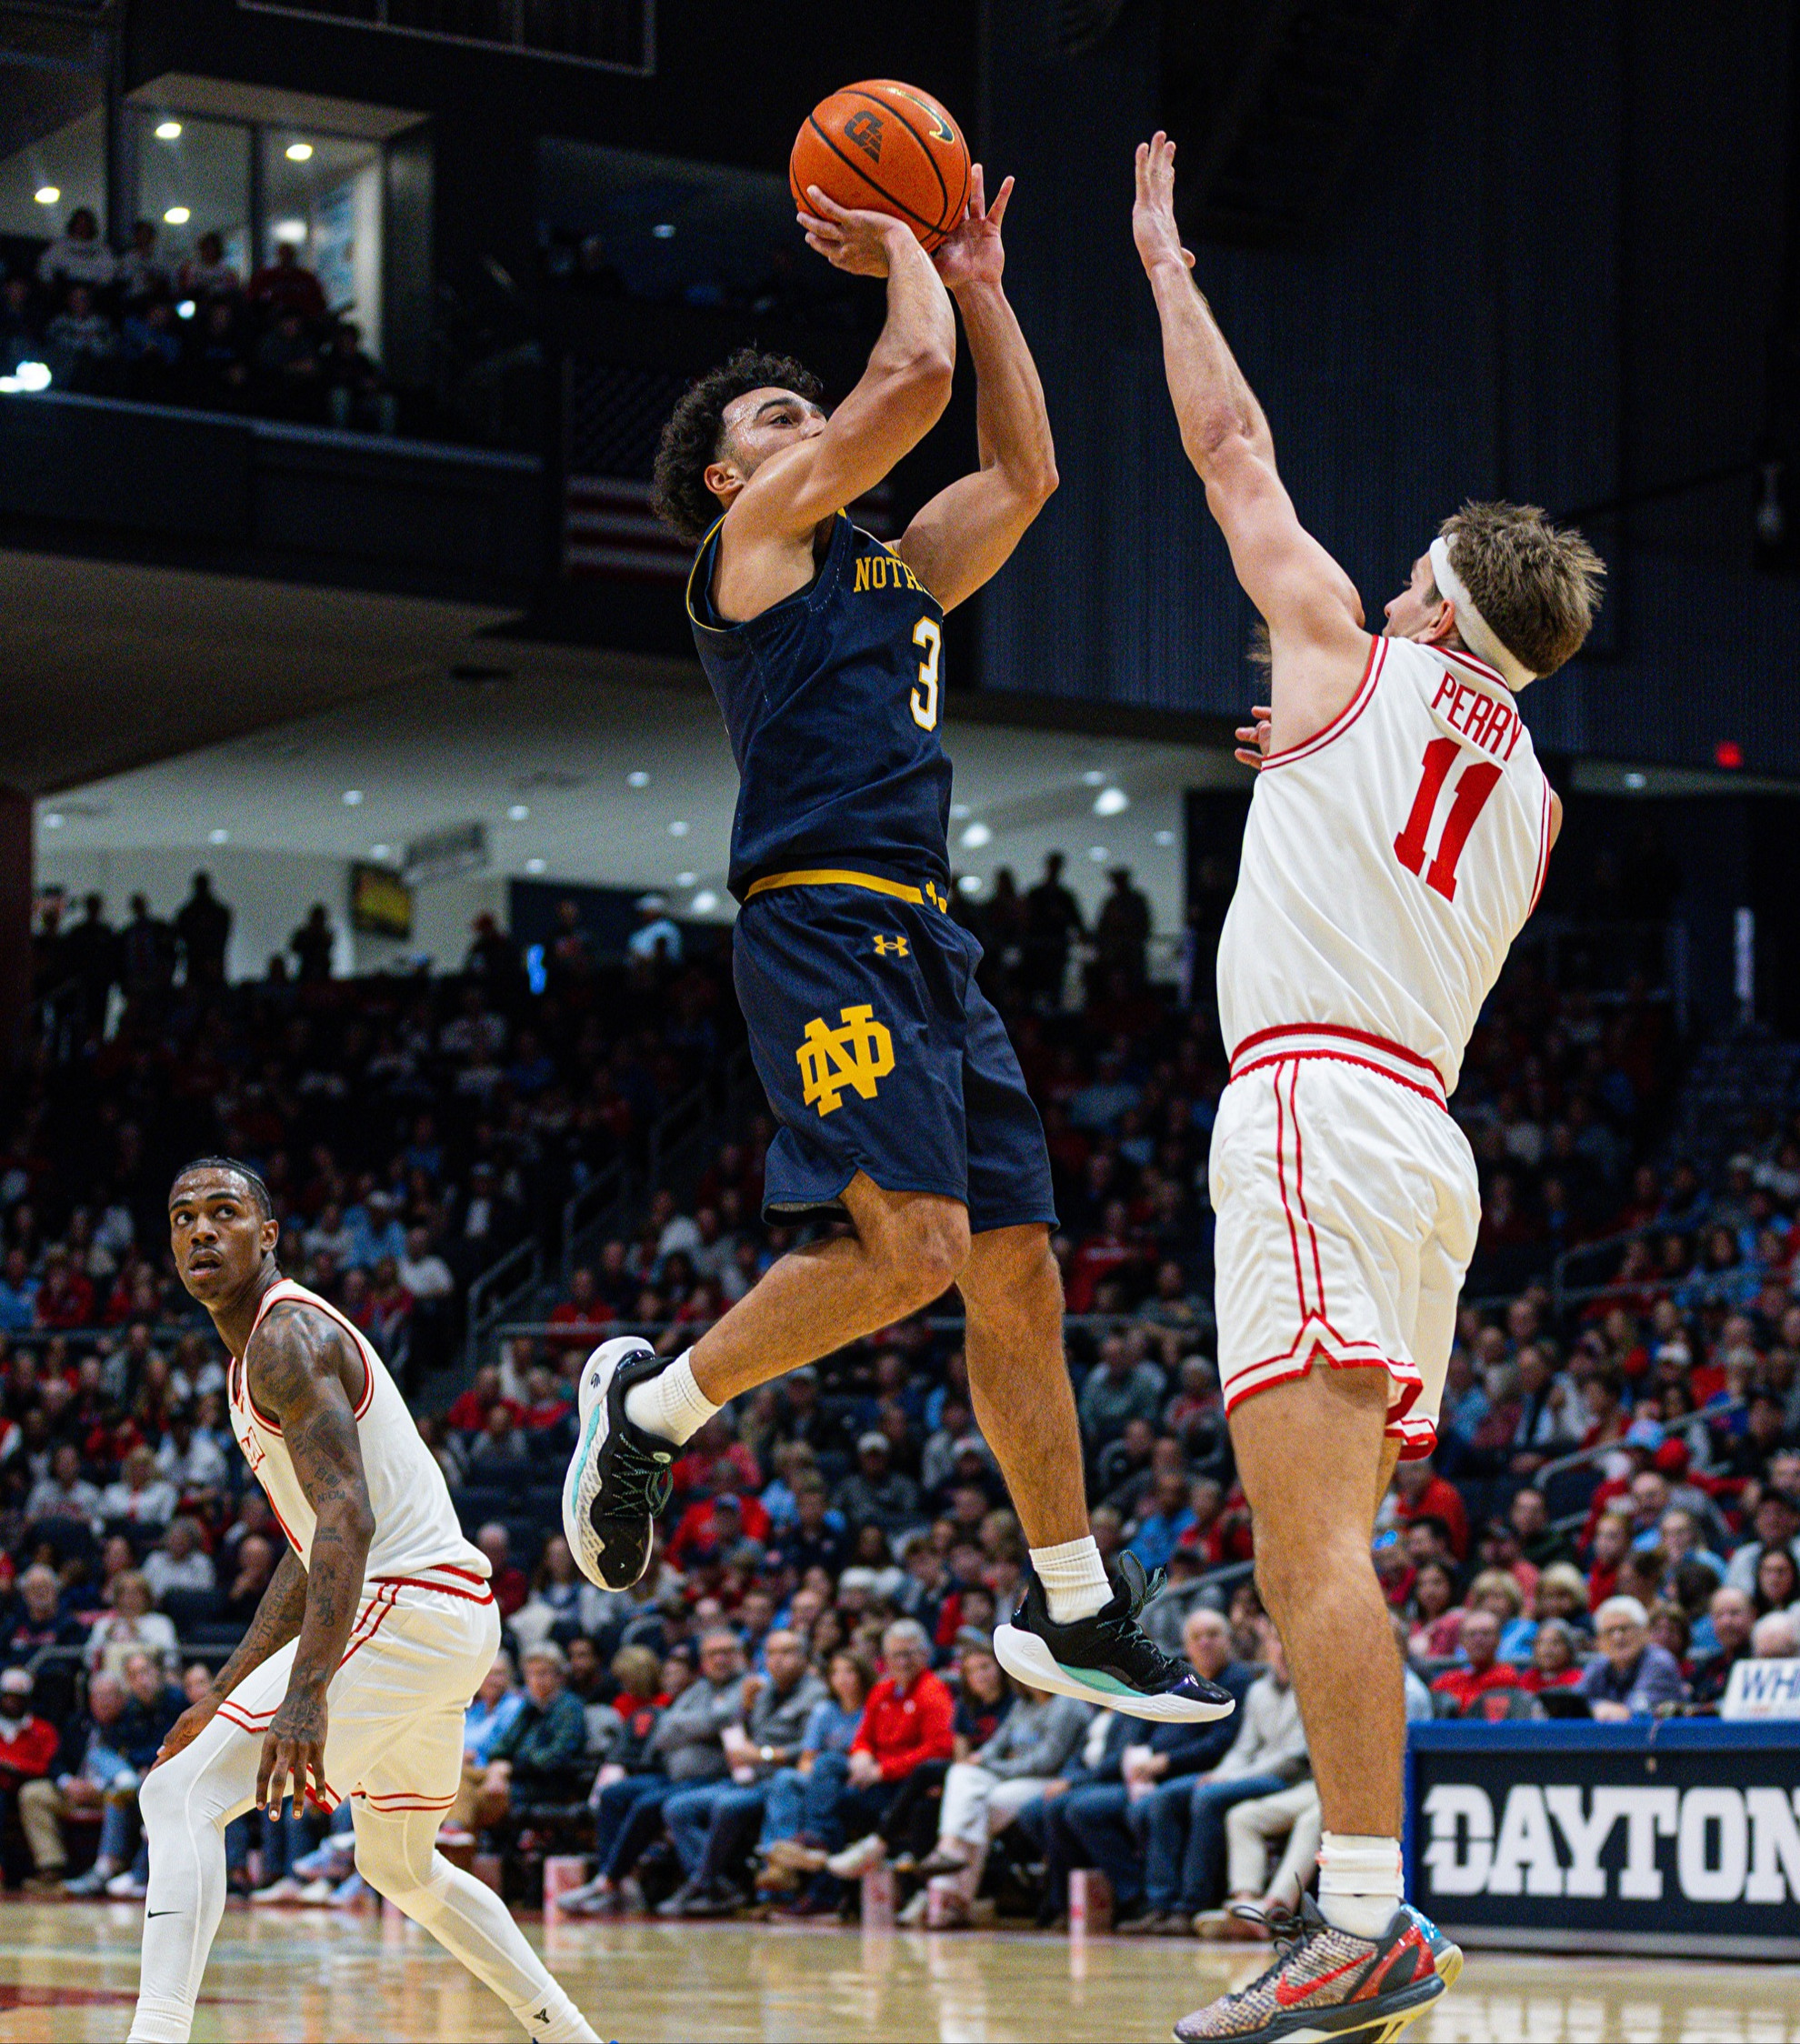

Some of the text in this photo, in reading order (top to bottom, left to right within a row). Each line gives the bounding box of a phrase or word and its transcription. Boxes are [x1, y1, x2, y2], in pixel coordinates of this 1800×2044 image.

[854, 556, 925, 593] NOTR
[910, 616, 942, 732] 3
[1431, 670, 1523, 762] PERRY
[1394, 737, 1504, 903] 11
[1422, 1783, 1800, 1905] DAYTON
